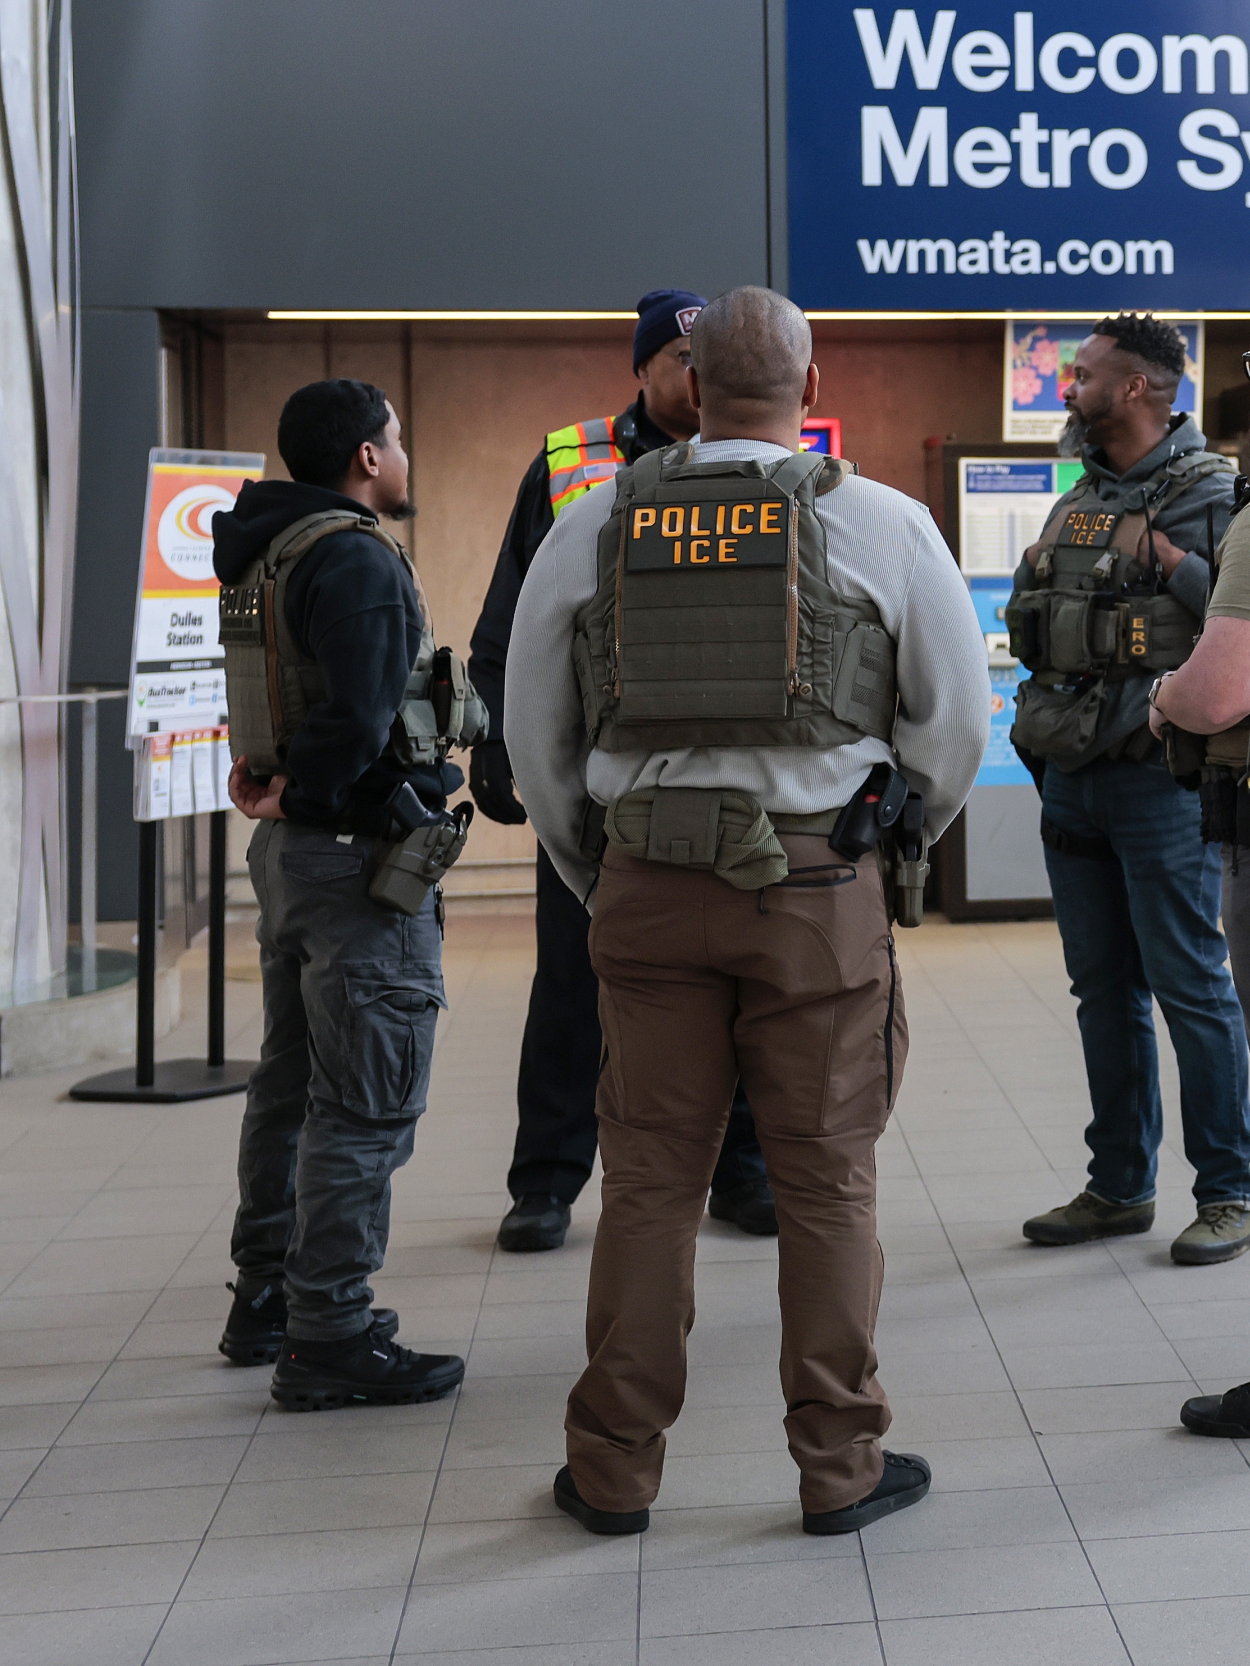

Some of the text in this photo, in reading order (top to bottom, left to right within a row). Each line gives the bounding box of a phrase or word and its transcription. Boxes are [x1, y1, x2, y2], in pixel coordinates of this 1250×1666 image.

[861, 106, 1149, 190] Metro
[857, 230, 1175, 275] wmata.com
[633, 502, 782, 540] POLICE
[1065, 513, 1116, 531] POLICE
[1070, 531, 1097, 545] ICE
[673, 538, 739, 565] ICE
[170, 612, 203, 627] Dulles
[166, 631, 204, 647] Station
